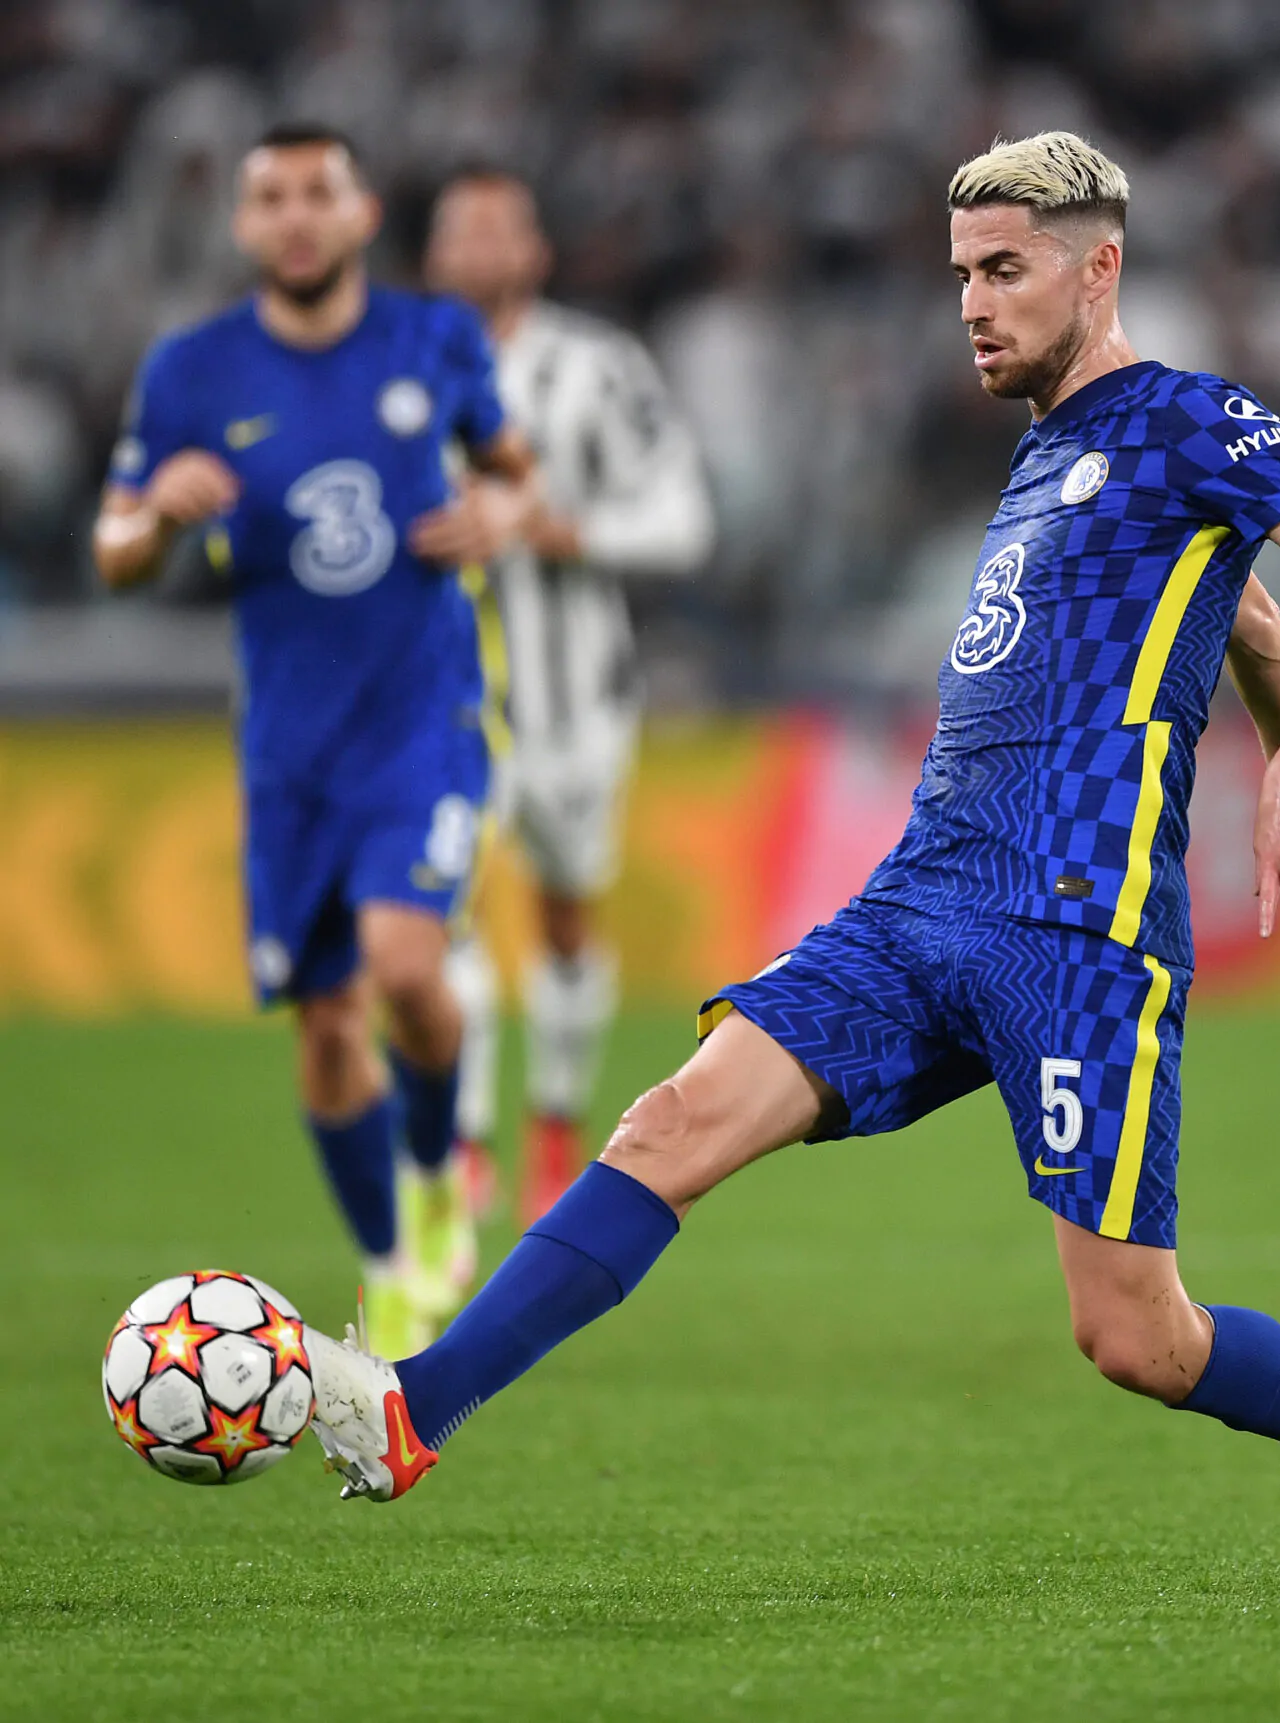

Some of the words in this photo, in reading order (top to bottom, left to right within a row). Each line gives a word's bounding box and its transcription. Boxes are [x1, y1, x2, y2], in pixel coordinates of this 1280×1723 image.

[284, 458, 397, 597] 3
[951, 542, 1027, 674] 3
[1040, 1056, 1083, 1154] 5
